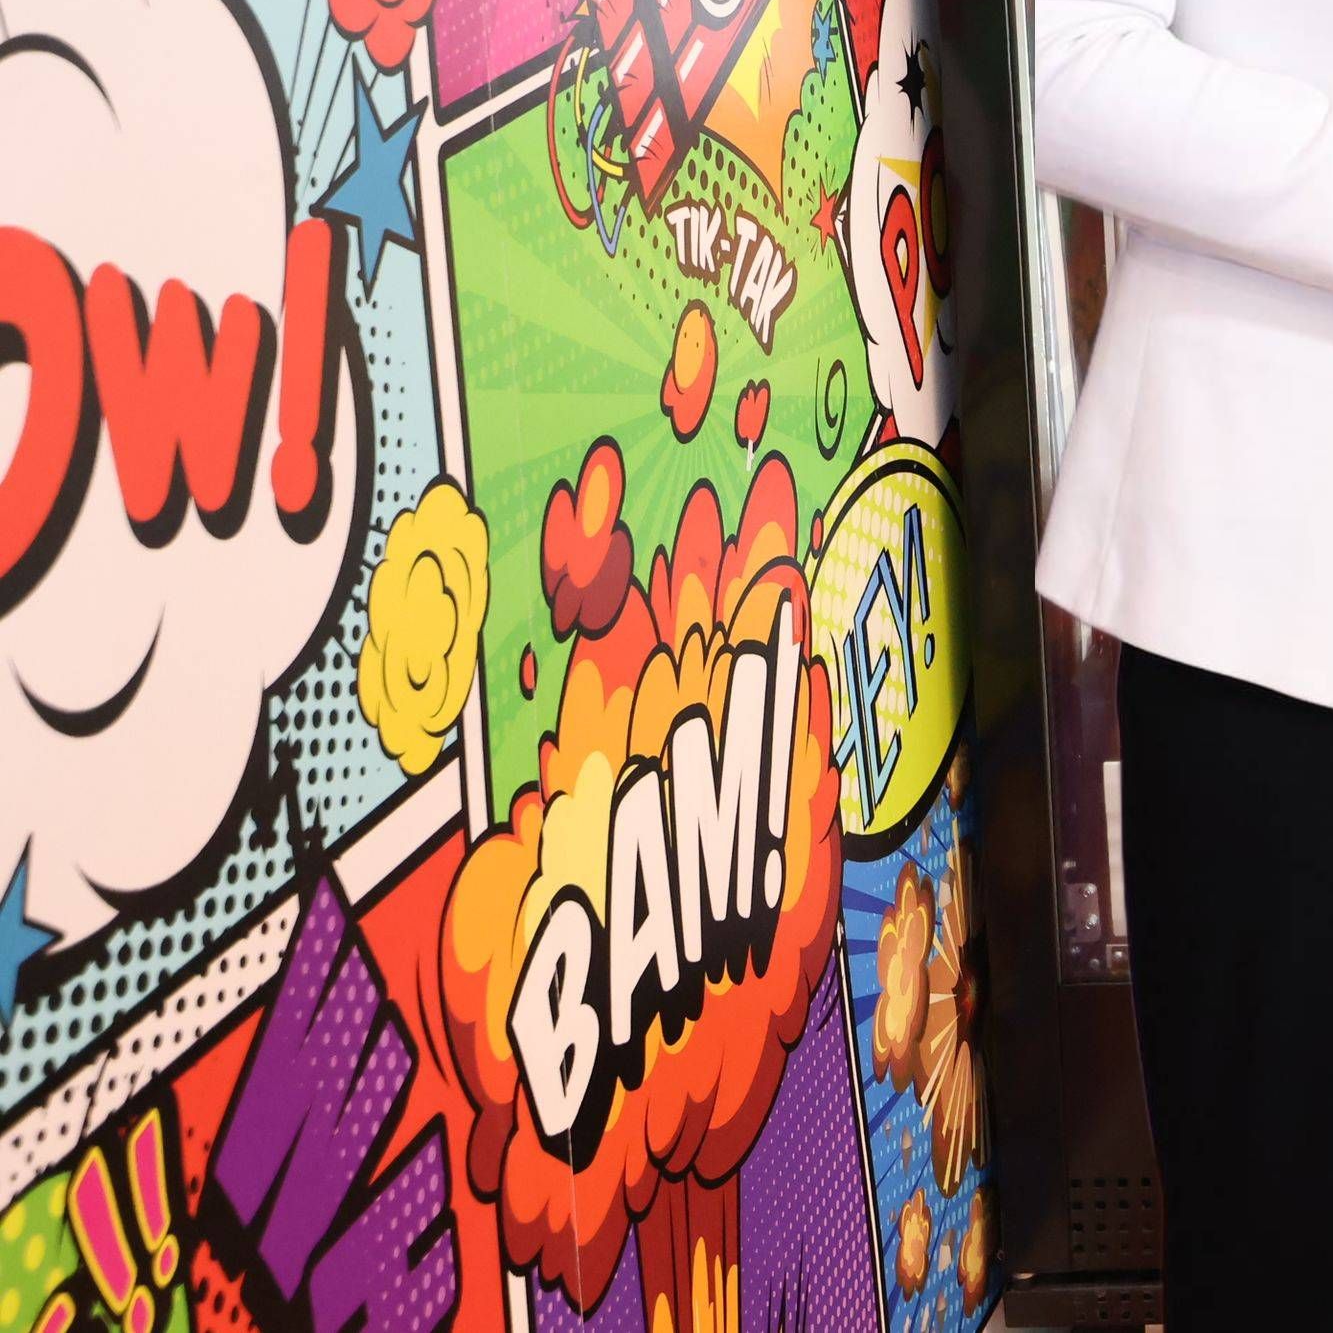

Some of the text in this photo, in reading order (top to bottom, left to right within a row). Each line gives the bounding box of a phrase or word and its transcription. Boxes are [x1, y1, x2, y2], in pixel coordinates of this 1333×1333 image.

[665, 199, 797, 353] TIK-TAK
[834, 503, 936, 829] HEY!
[509, 590, 801, 1146] BAM!
